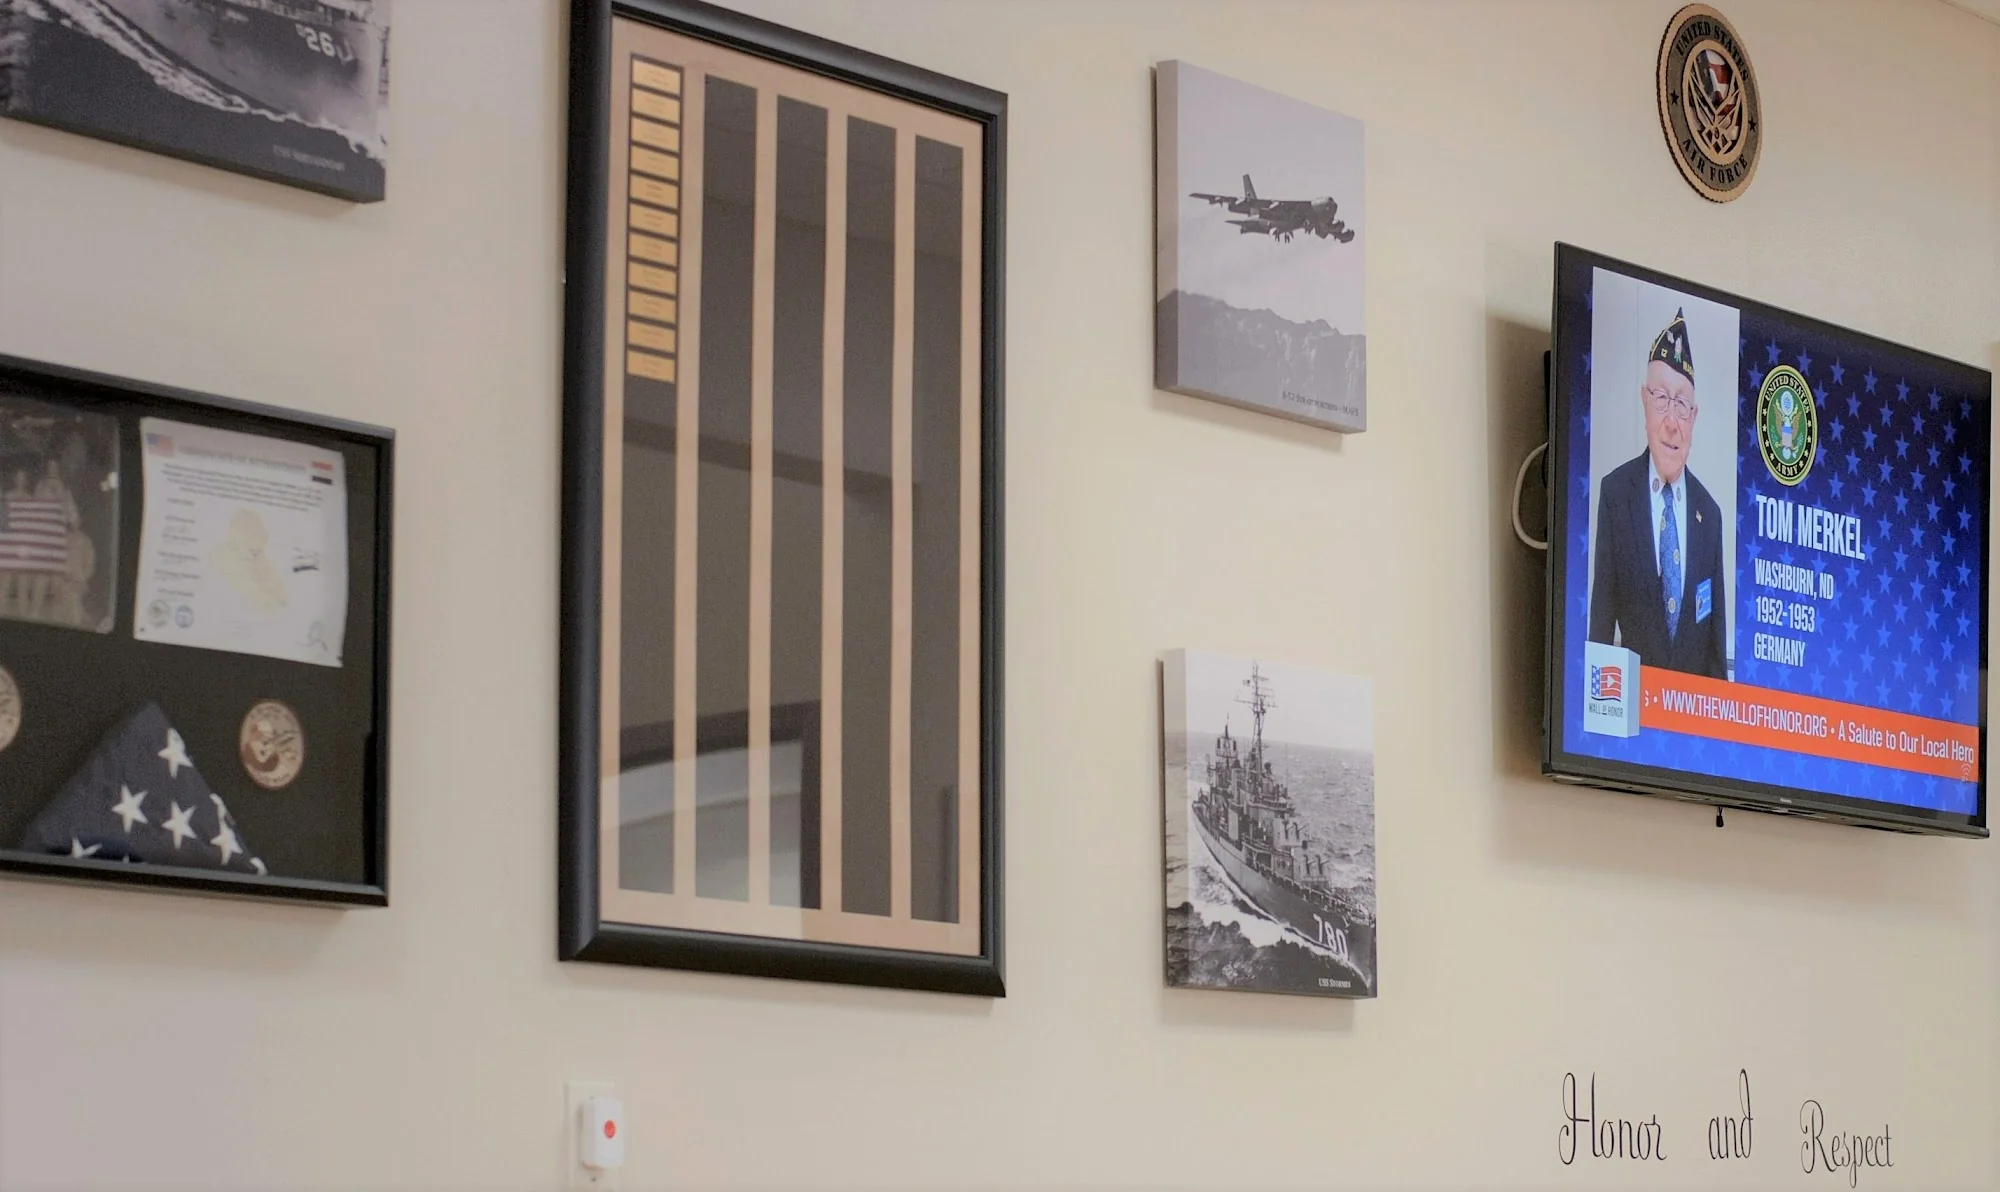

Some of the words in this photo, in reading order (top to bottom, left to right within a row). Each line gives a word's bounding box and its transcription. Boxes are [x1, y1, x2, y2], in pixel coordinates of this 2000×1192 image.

[1675, 21, 1712, 57] UNITED
[1713, 25, 1749, 83] STATES
[1682, 138, 1706, 174] AIR
[1709, 153, 1749, 185] FORCE
[1764, 375, 1790, 402] UNITED
[1788, 377, 1811, 414] STATES
[1775, 462, 1799, 477] ARMY
[1755, 493, 1793, 544] TOM
[1797, 503, 1866, 561] MERKEL
[1754, 557, 1818, 601] WASHBURN,
[1818, 572, 1834, 601] ND
[1755, 595, 1816, 633] 1952-1953
[1753, 631, 1806, 667] GERMANY
[1588, 703, 1601, 715] WALL
[1608, 706, 1624, 718] HONOR
[1661, 687, 1828, 738] WWW.THEWALLOFHONOR.ORG
[1837, 719, 1846, 742] A
[1848, 721, 1883, 747] Salute
[1885, 729, 1896, 750] to
[1899, 731, 1919, 754] Our
[1921, 734, 1949, 759] Local
[1951, 739, 1974, 764] Hero
[1313, 913, 1349, 959] 780
[1559, 1071, 1668, 1166] Honor
[1707, 1068, 1754, 1160] and
[1799, 1099, 1895, 1189] Respect
